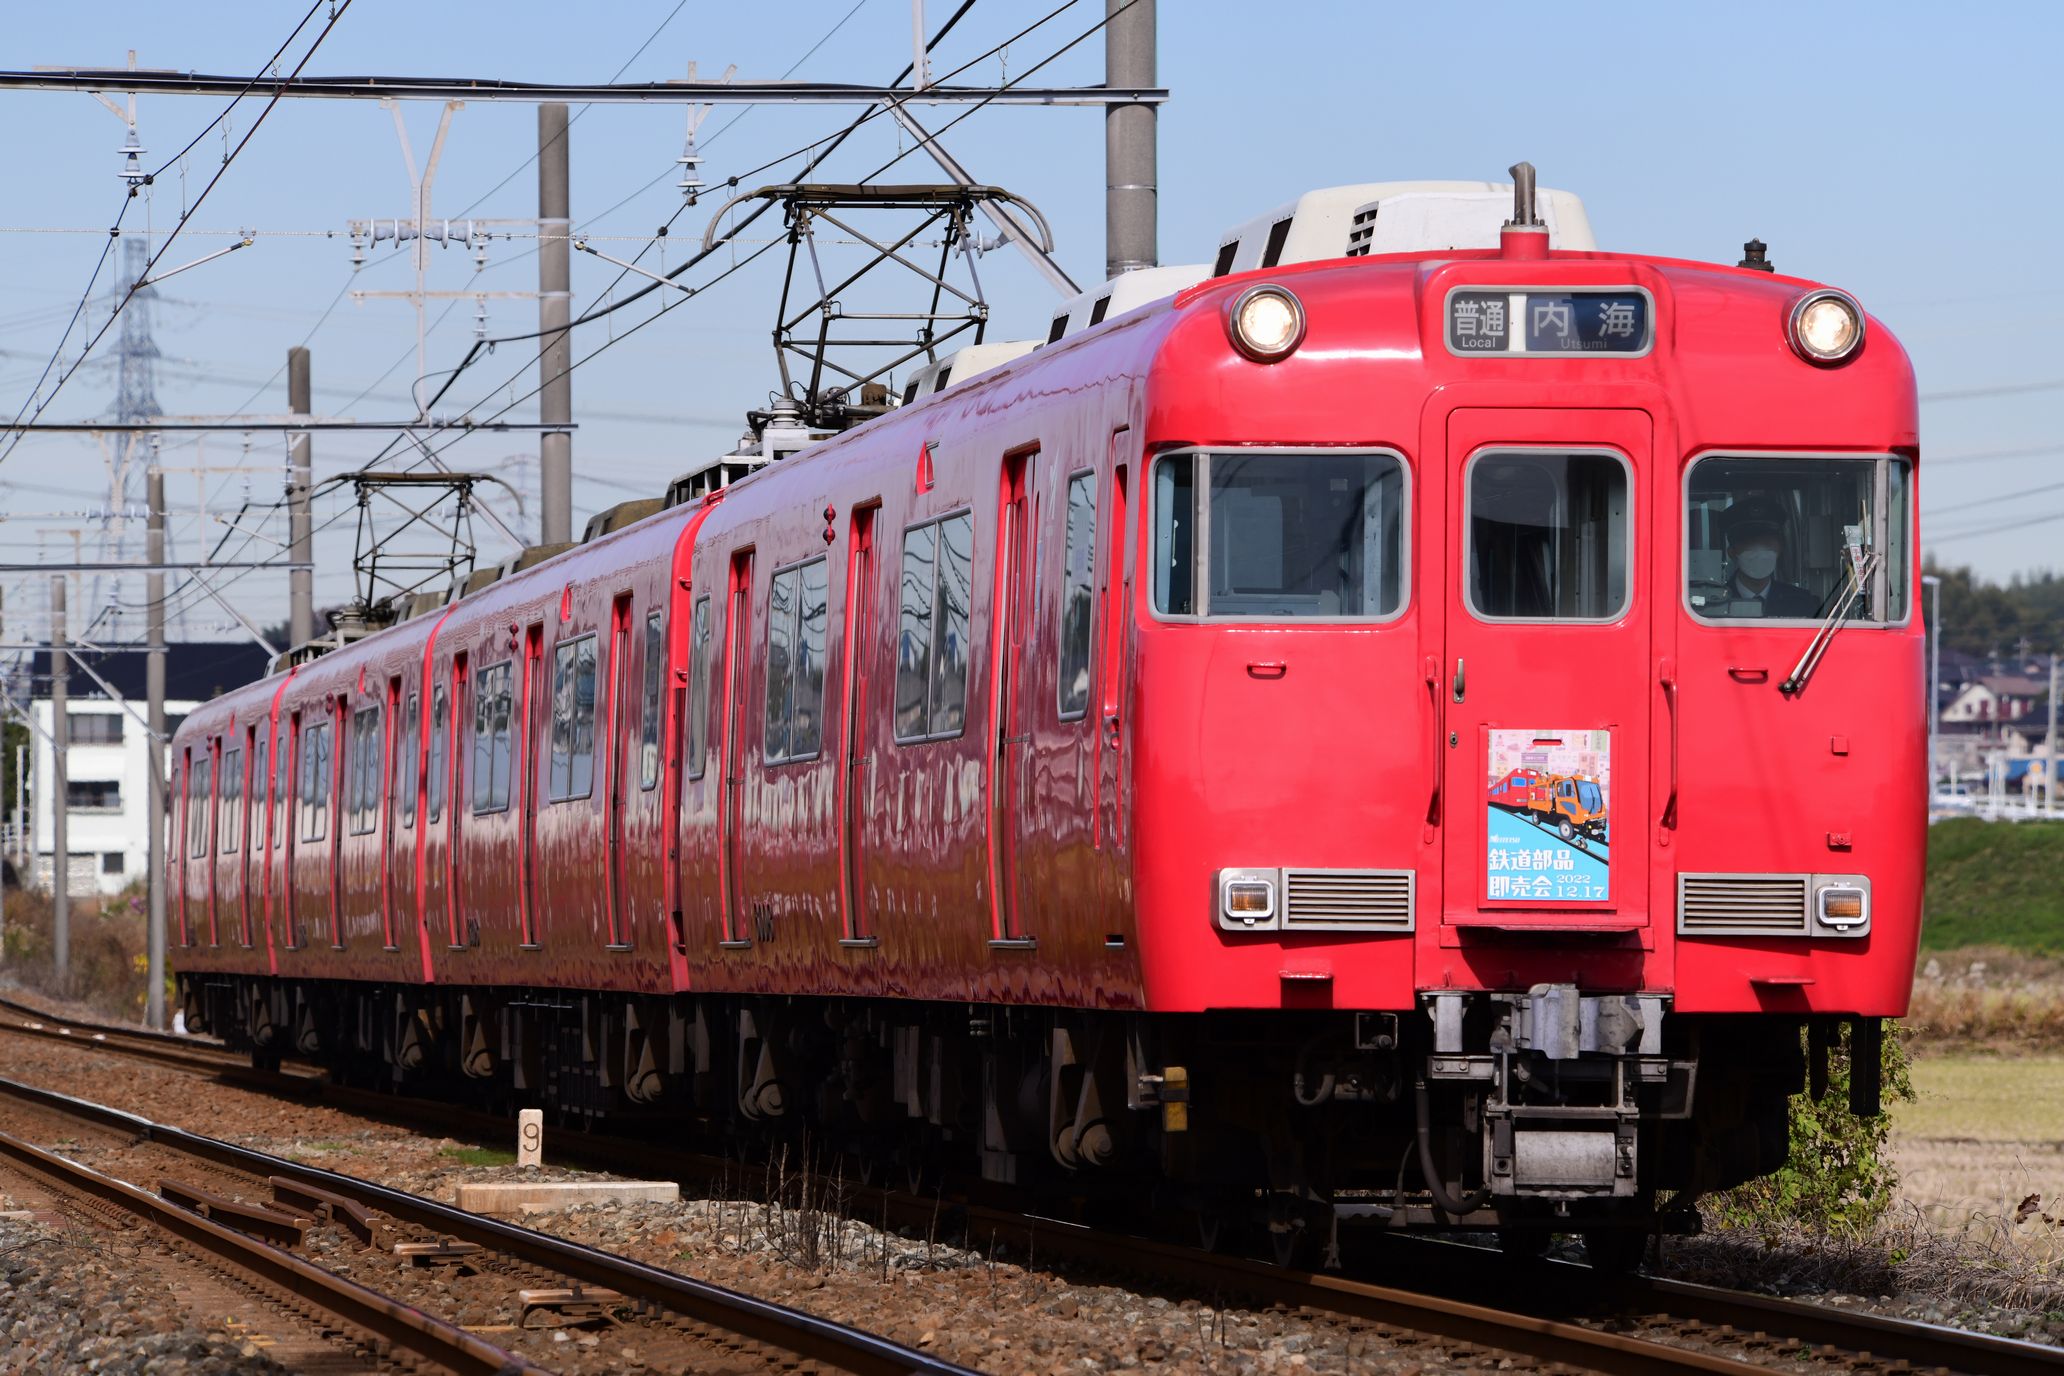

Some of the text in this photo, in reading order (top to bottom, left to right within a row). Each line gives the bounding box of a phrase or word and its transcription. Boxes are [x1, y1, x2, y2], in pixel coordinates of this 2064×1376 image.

[1454, 300, 1504, 336] 普通
[1533, 302, 1635, 337] 内海
[1462, 337, 1496, 348] Local
[1560, 338, 1608, 349] Utsumi
[1489, 848, 1574, 870] 鉄道部品
[1489, 875, 1552, 897] 即売会
[1556, 874, 1591, 883] 2022
[1556, 885, 1605, 898] 12.17
[523, 1122, 540, 1152] 9
